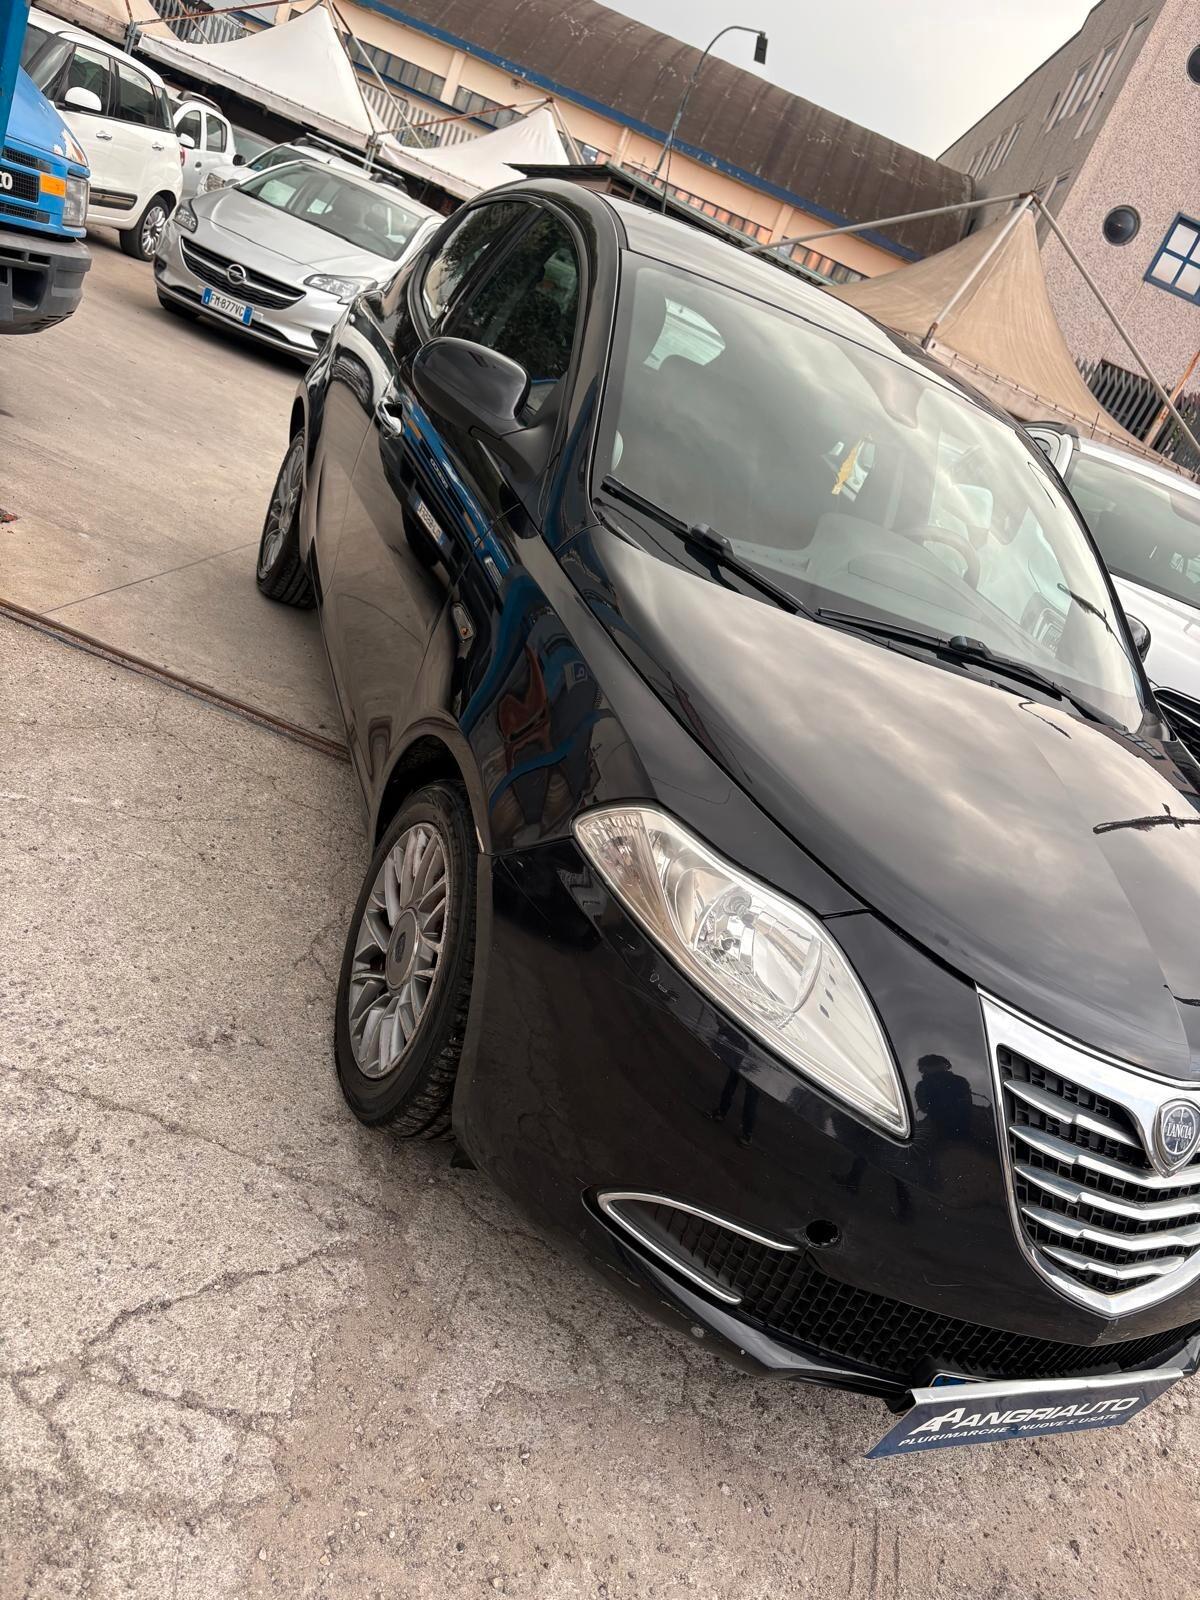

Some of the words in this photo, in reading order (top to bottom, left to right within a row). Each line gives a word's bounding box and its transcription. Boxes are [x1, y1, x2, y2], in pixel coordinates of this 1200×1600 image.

[1166, 1122, 1192, 1139] LANCIA
[898, 1426, 1011, 1447] PLURIMARCHE
[1018, 1419, 1067, 1431] NUOVE
[1078, 1413, 1121, 1424] USATE
